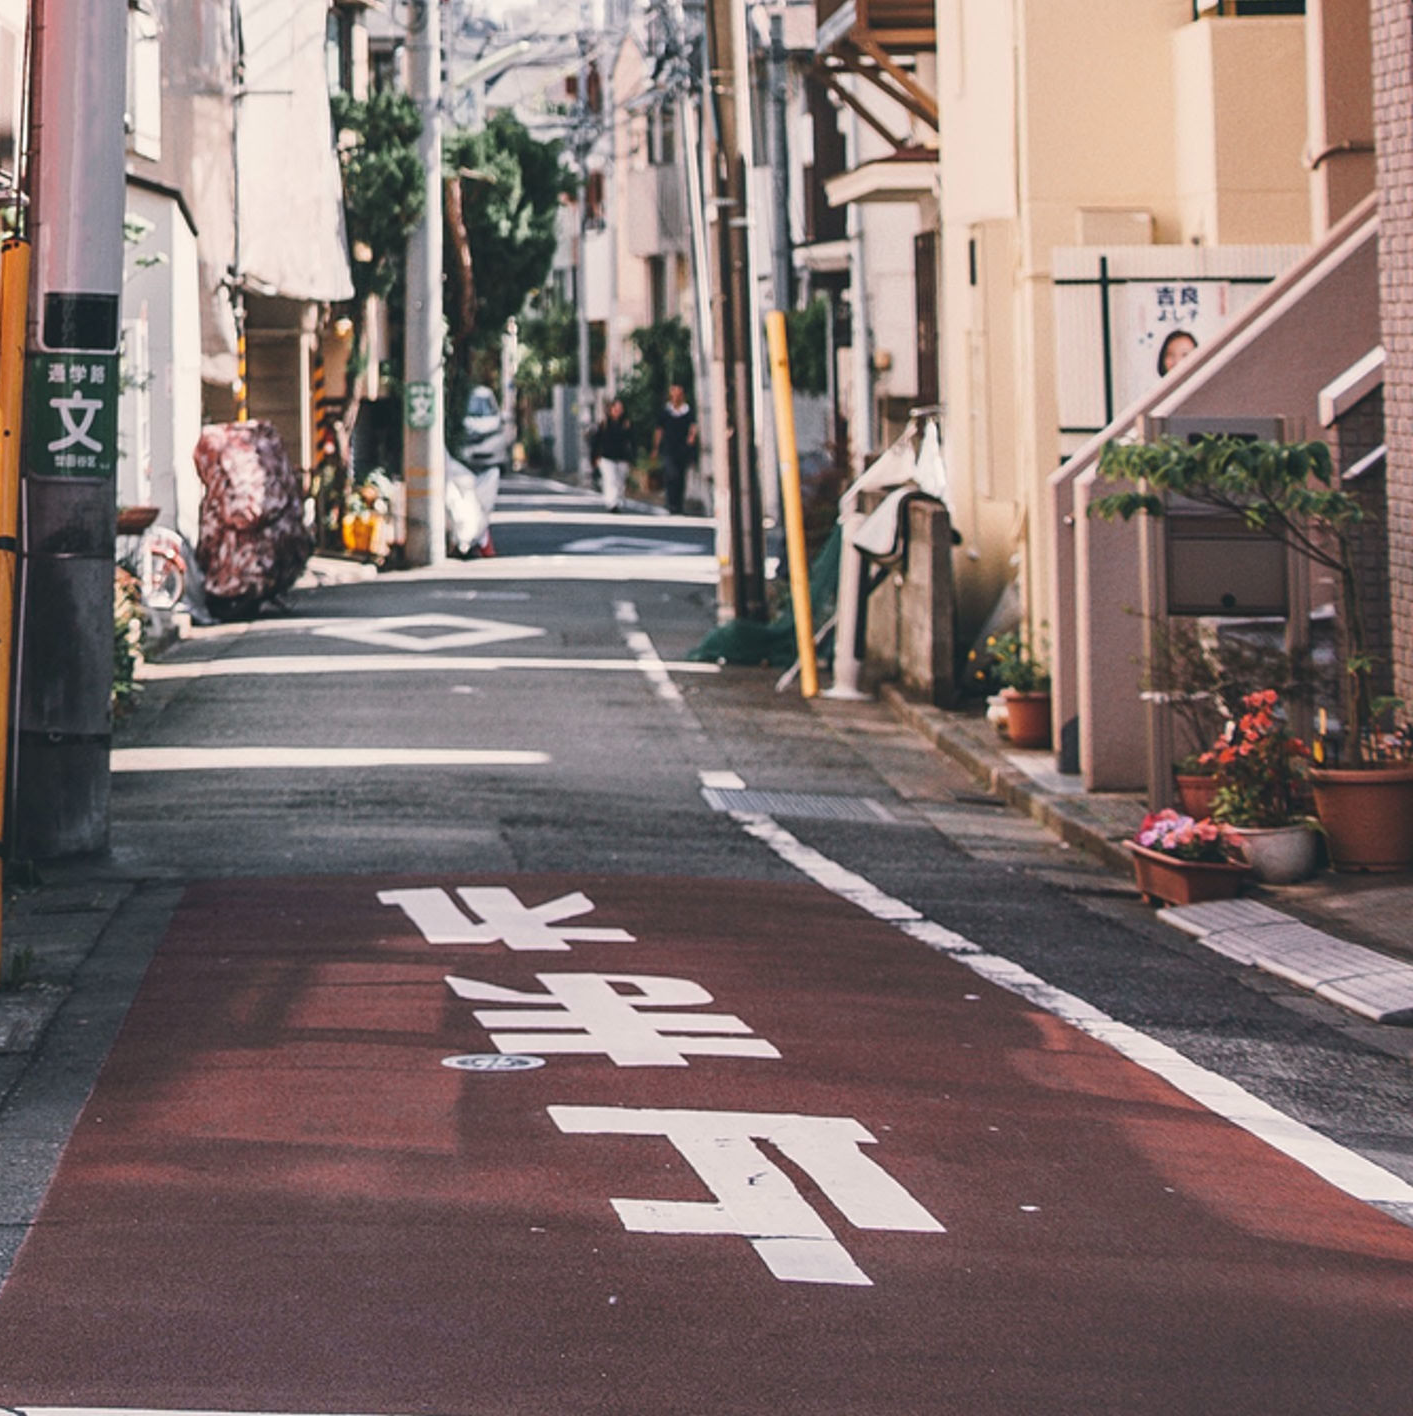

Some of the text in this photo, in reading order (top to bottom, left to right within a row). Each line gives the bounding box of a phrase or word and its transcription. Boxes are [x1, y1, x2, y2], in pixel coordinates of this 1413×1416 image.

[1156, 286, 1198, 306] 吉良
[47, 362, 106, 384] 通学路
[47, 389, 104, 453] 文
